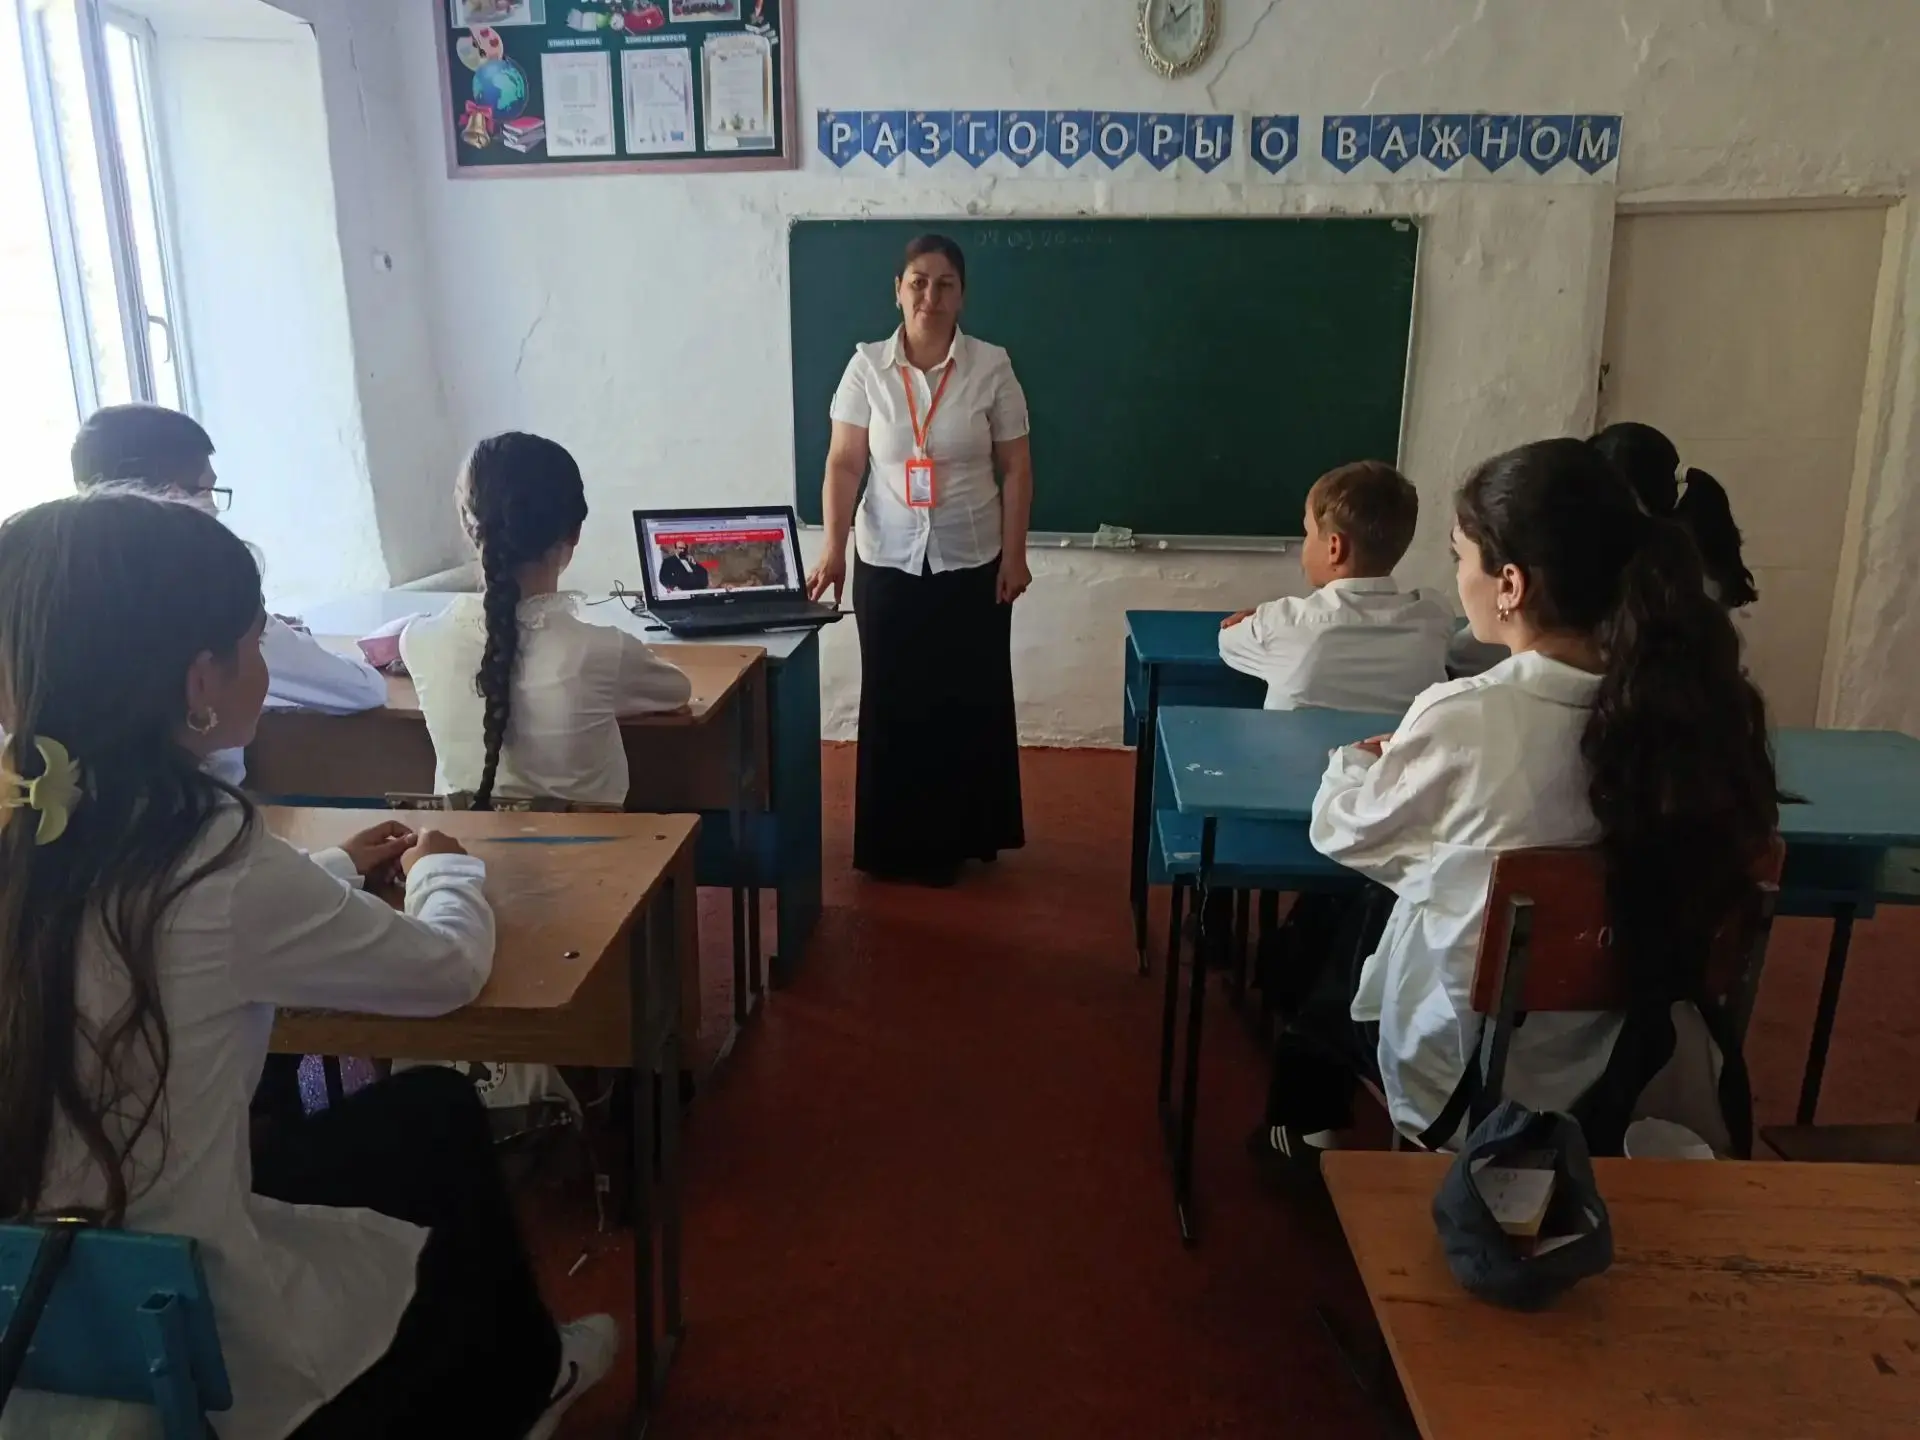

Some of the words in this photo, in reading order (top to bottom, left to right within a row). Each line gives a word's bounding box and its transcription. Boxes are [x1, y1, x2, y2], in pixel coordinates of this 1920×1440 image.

[831, 121, 1223, 160] РАЗГОВОРЫ
[1260, 126, 1290, 162] О
[1336, 125, 1612, 162] ВАЖНОМ
